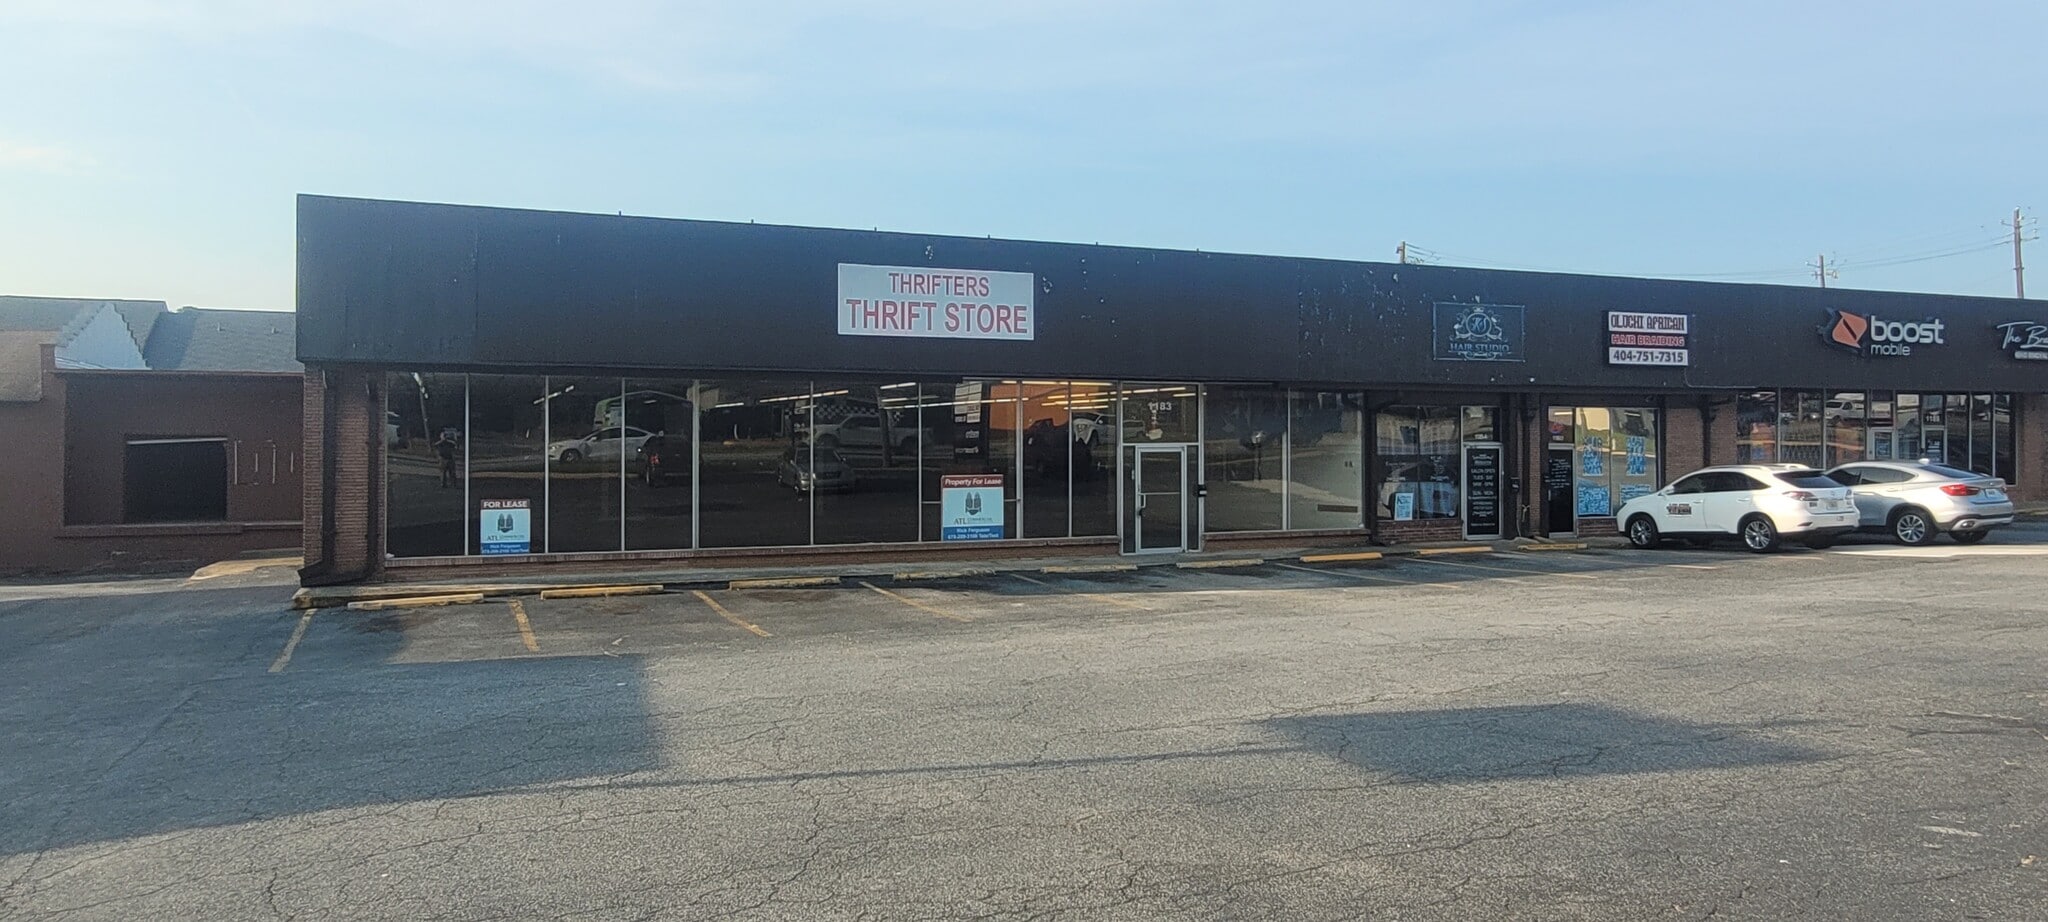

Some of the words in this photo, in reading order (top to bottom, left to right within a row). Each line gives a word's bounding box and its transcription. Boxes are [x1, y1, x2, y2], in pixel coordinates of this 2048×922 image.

[889, 273, 990, 297] THRIFTERS
[846, 299, 937, 331] THRIFT
[944, 303, 1028, 334] STORE
[1611, 314, 1644, 329] OLUCHI
[1647, 316, 1685, 331] AFRICAN
[1870, 315, 1944, 344] boost
[1996, 321, 2034, 349] The
[1611, 334, 1636, 345] HAIR
[1637, 335, 1685, 347] BRAIDING
[1450, 343, 1473, 351] HAIR
[1475, 343, 1510, 352] STUDIO
[1870, 343, 1911, 356] mobile
[1613, 350, 1684, 363] 404-751-7315
[1148, 402, 1172, 411] 1183
[944, 479, 971, 487] Property
[502, 500, 528, 508] LEASE
[954, 517, 966, 525] ATL
